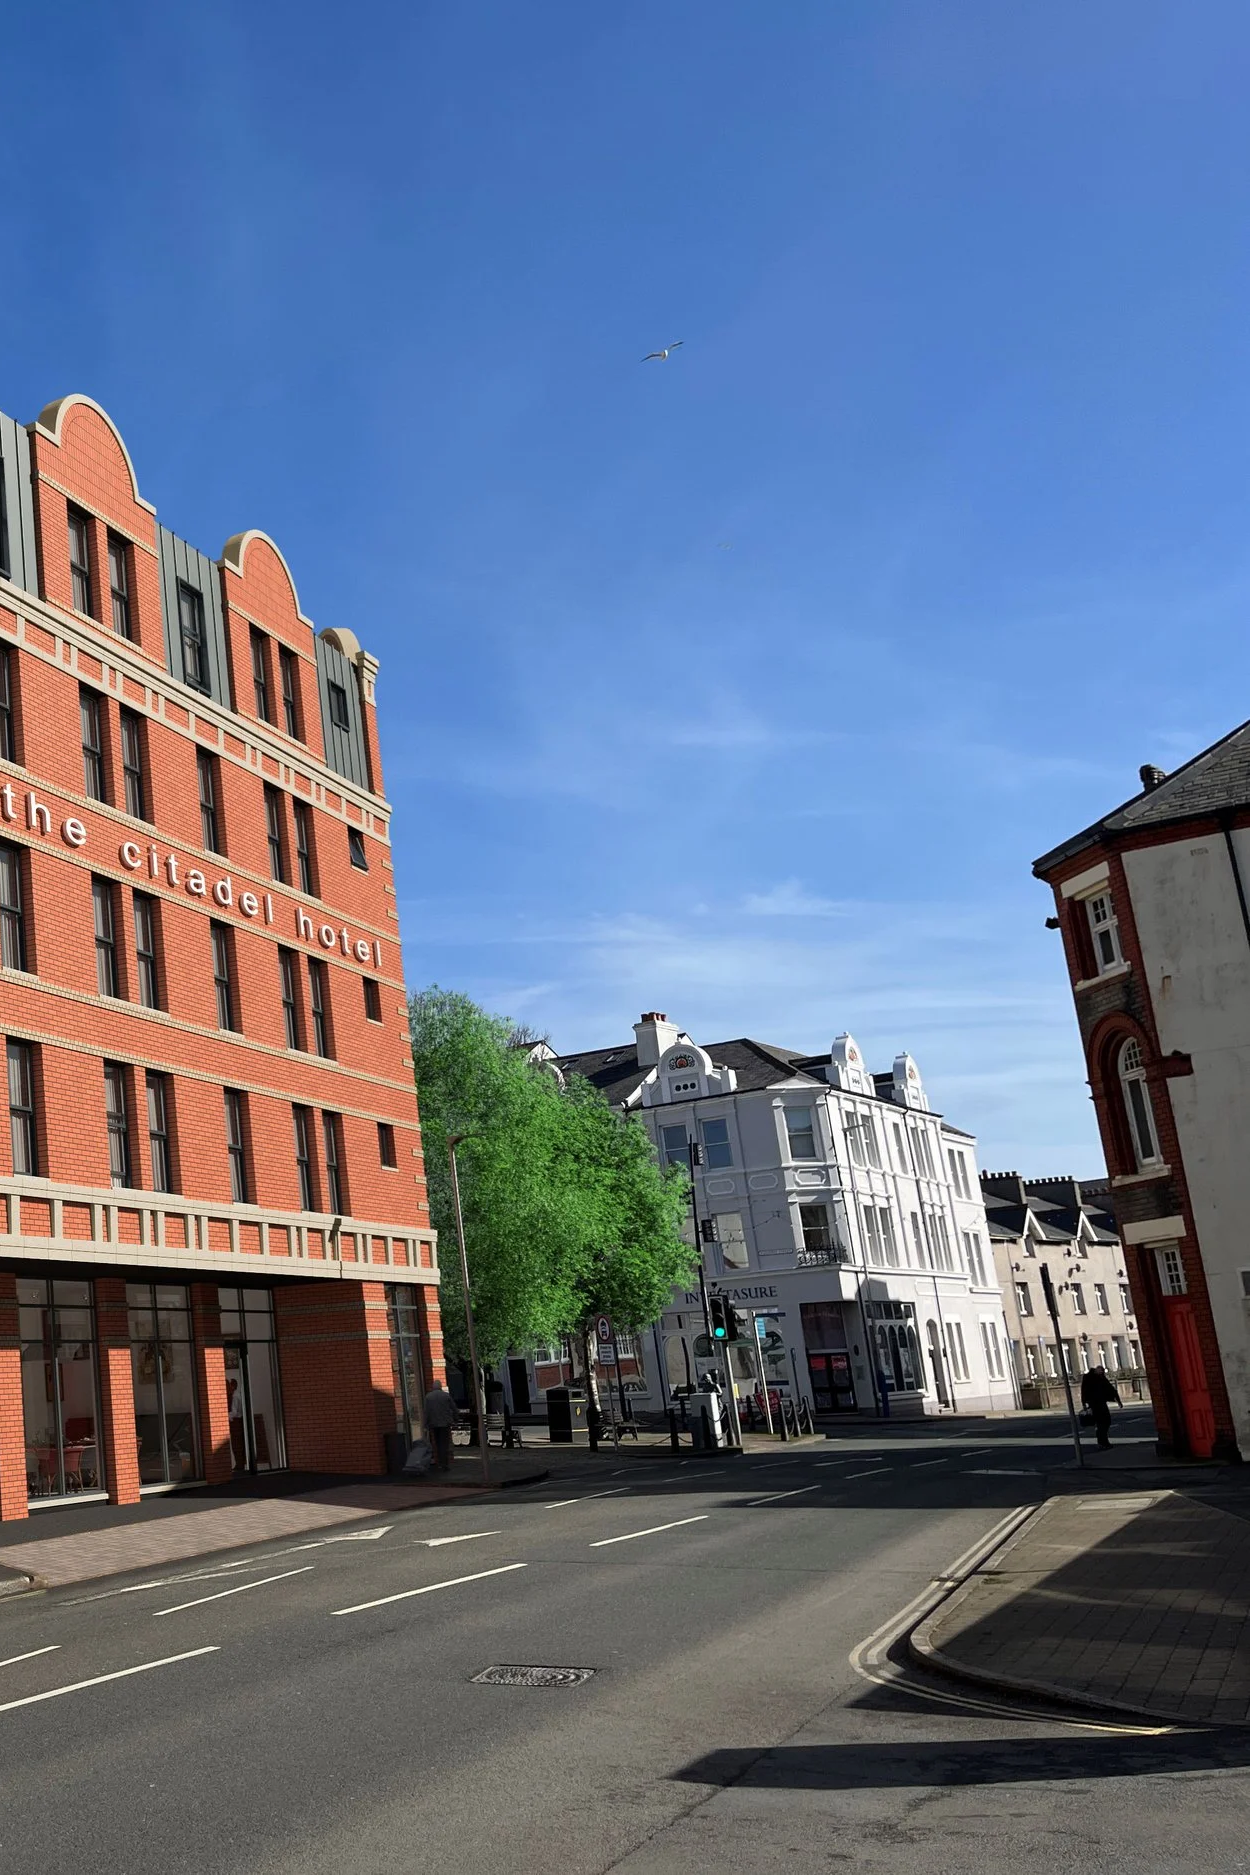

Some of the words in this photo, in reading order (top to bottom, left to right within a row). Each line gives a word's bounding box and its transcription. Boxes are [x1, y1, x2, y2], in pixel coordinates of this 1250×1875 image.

[119, 841, 274, 925] citadel
[295, 907, 382, 967] hotel
[685, 1285, 778, 1305] INTASURE
